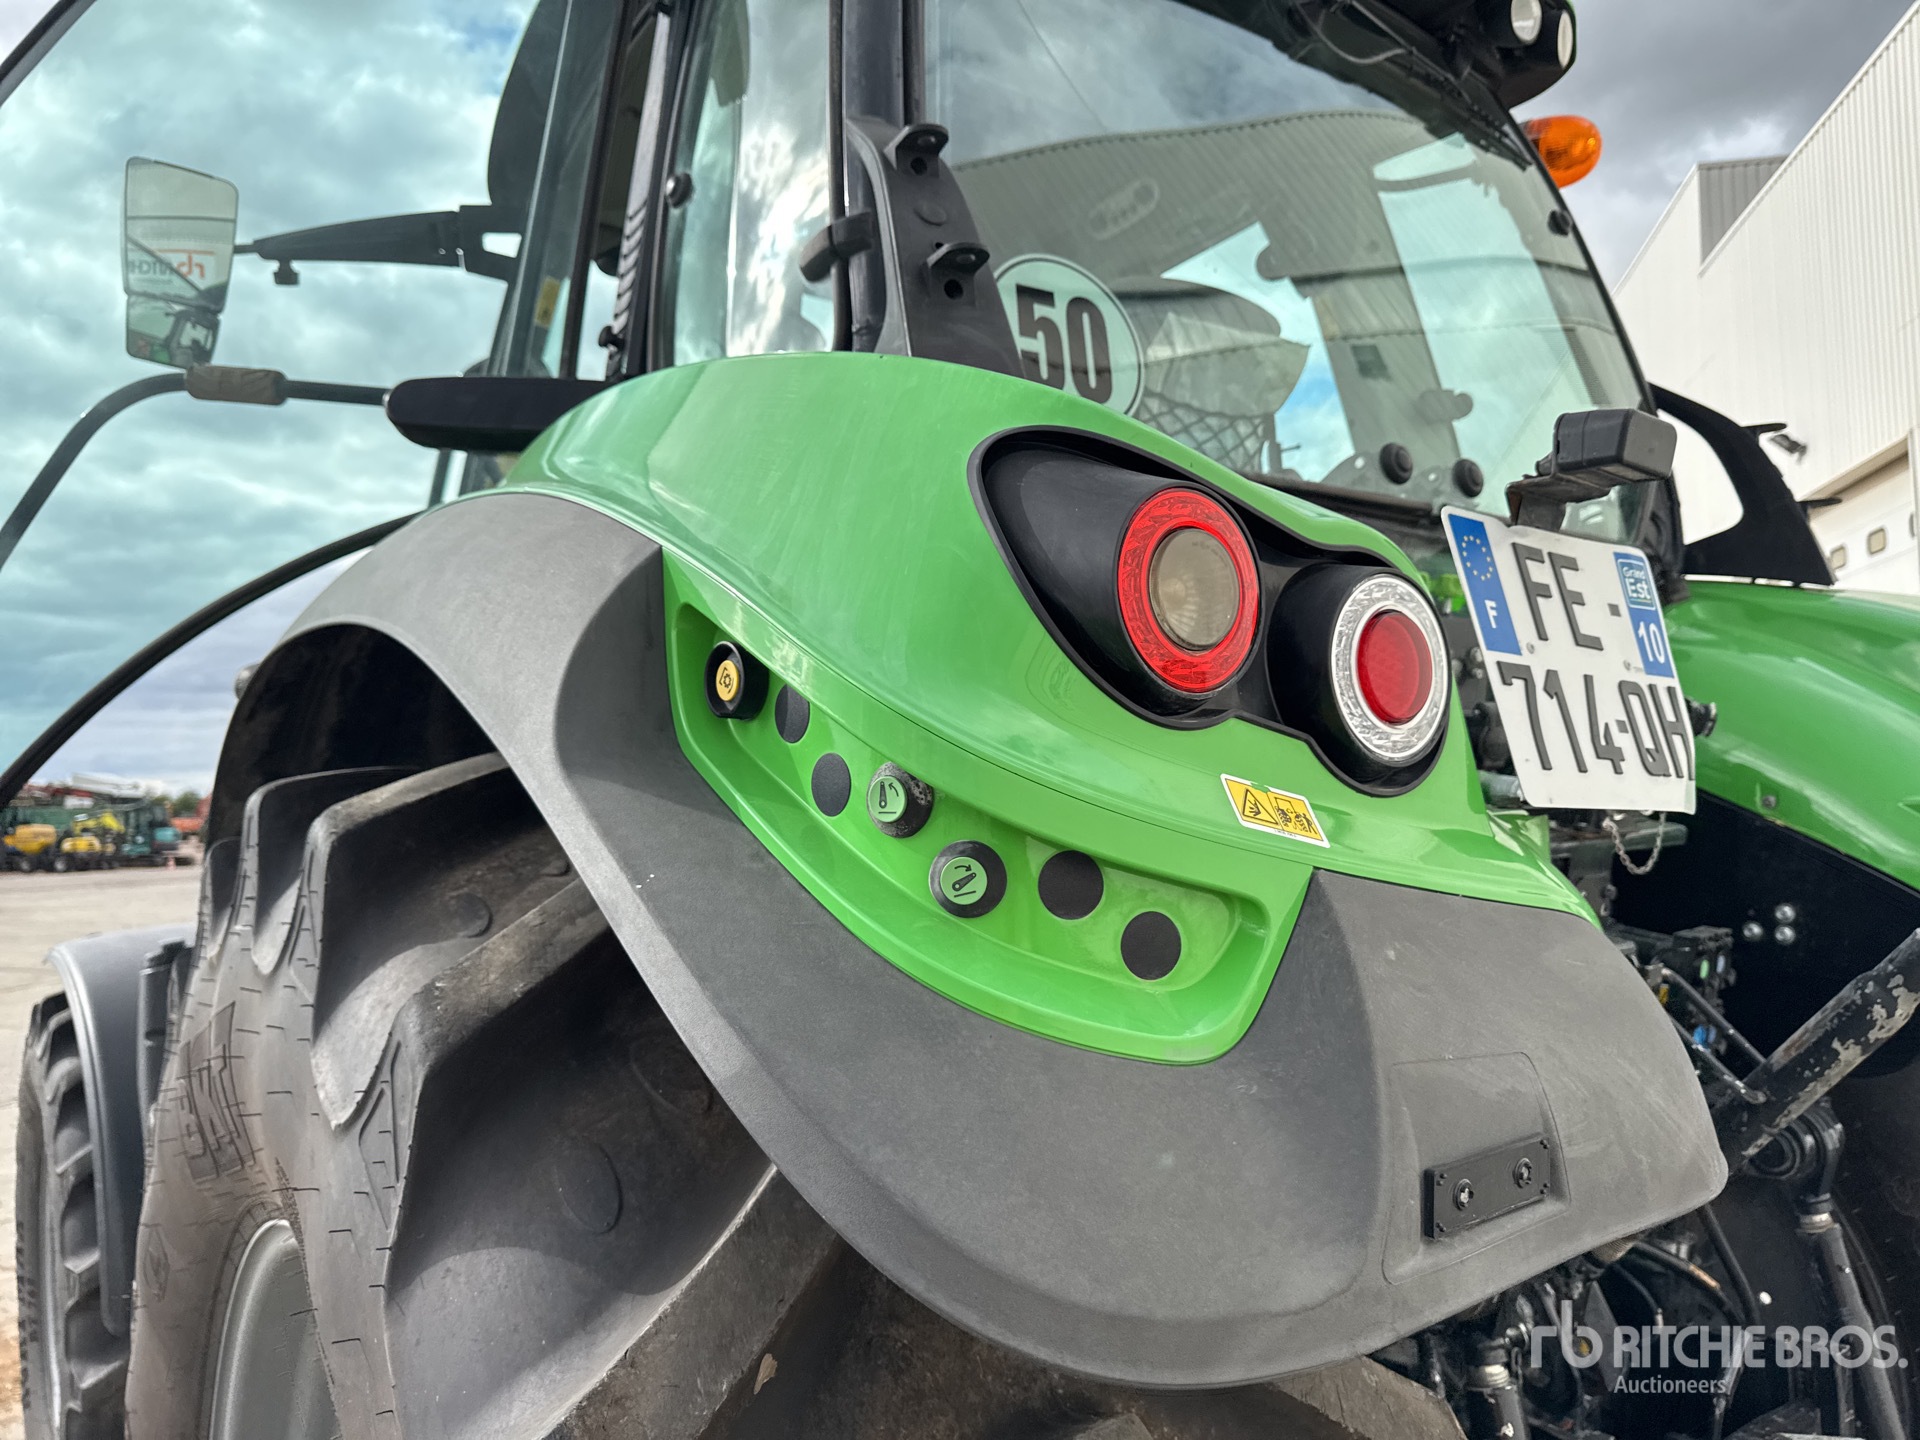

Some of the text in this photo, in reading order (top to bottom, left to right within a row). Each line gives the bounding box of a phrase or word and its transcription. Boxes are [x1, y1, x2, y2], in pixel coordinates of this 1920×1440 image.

[1015, 283, 1113, 404] 50
[1625, 578, 1651, 599] Est
[1484, 599, 1499, 629] F
[1638, 621, 1665, 663] 10
[1496, 660, 1694, 781] 714-QH
